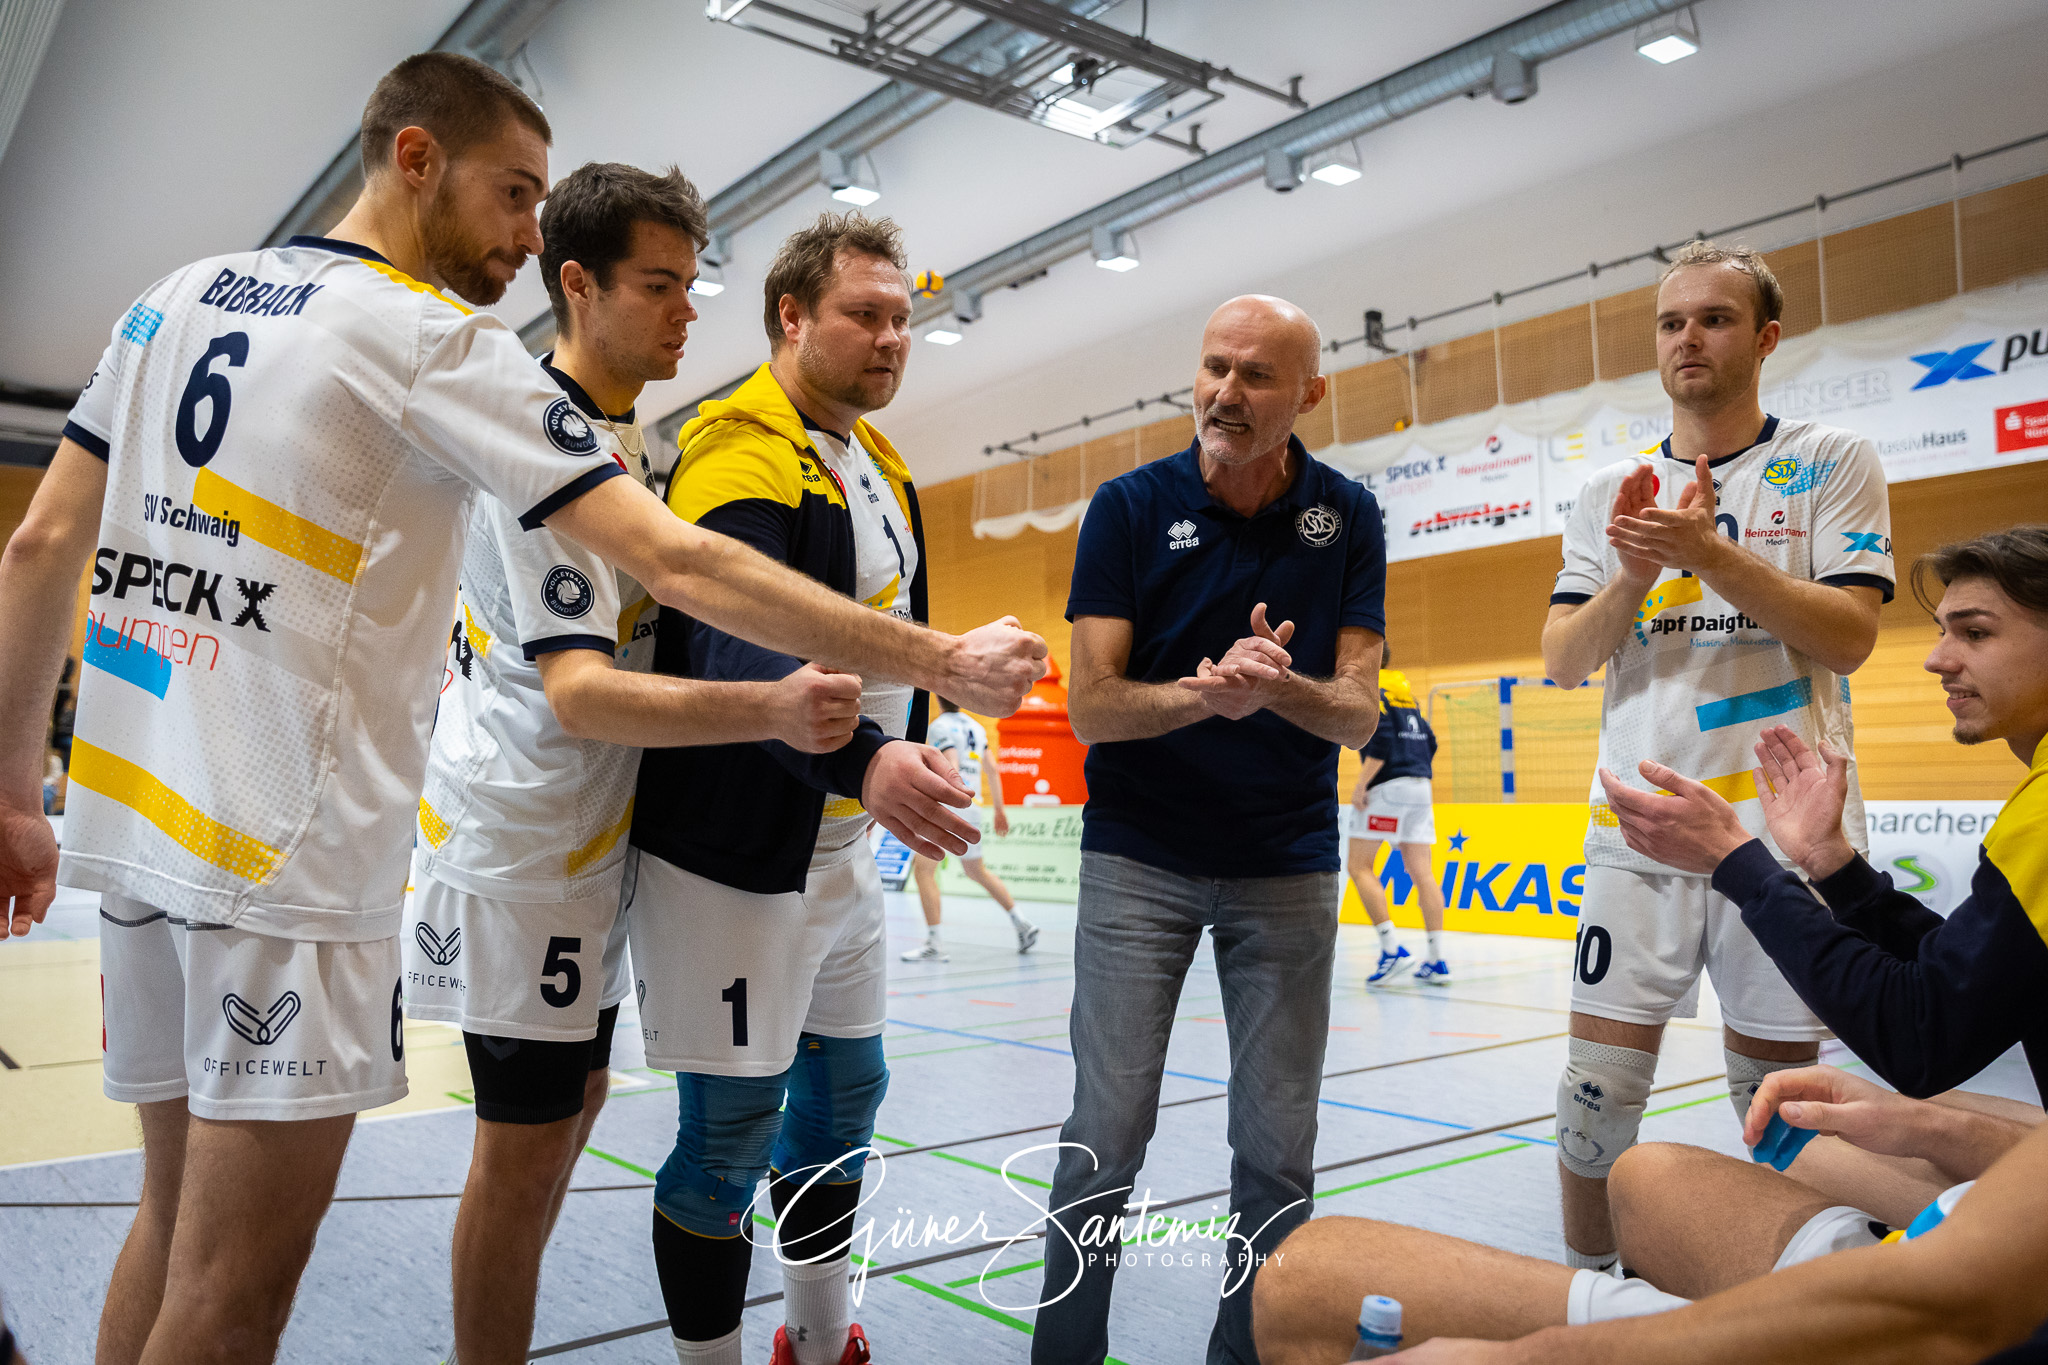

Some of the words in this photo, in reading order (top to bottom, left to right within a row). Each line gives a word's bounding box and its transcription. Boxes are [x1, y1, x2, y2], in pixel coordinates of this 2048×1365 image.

[175, 331, 249, 468] 6
[1385, 460, 1432, 484] SPECK
[144, 493, 158, 523] SV
[160, 496, 241, 548] Schwaig
[1744, 527, 1807, 539] Heinzelmann
[881, 514, 906, 580] 1
[90, 547, 223, 622] SPECK
[548, 571, 586, 592] VOLLEYBALL
[550, 596, 588, 614] BUNDESLIGA
[1650, 615, 1687, 635] Zapf
[1690, 611, 1764, 635] Daigfu
[540, 936, 581, 1008] 5
[722, 977, 748, 1046] 1
[204, 1057, 327, 1076] OFFICEWELT
